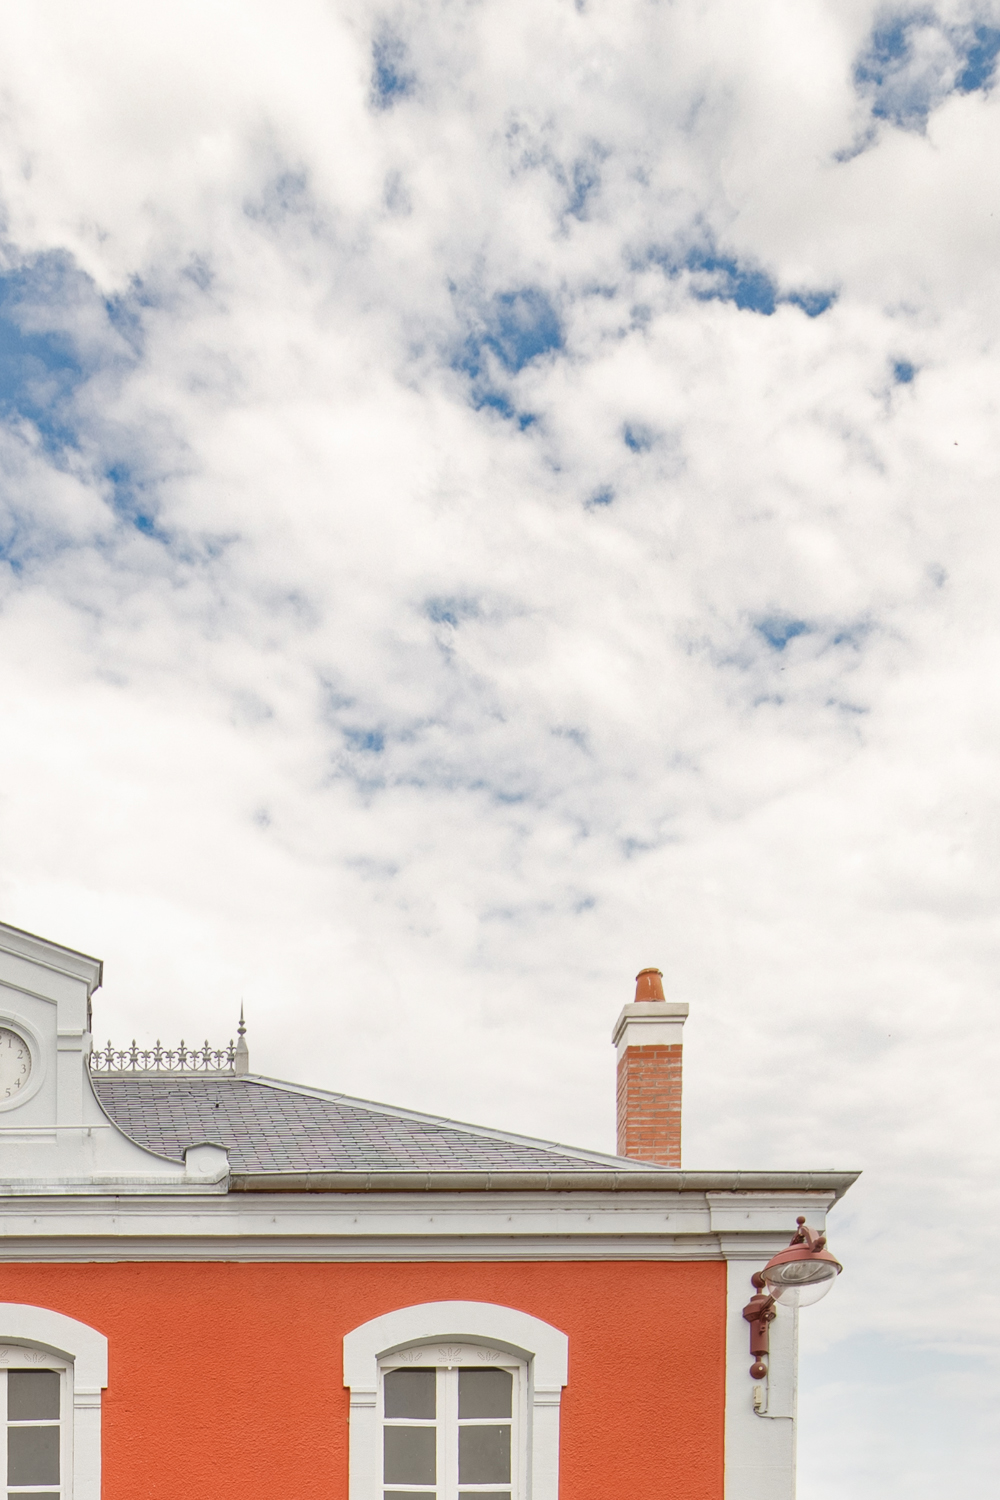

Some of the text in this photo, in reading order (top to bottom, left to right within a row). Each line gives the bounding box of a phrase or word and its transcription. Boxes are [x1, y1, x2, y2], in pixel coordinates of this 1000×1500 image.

[17, 1050, 23, 1059] 2
[20, 1064, 27, 1074] 3
[14, 1078, 21, 1088] 4
[5, 1088, 11, 1098] 5
